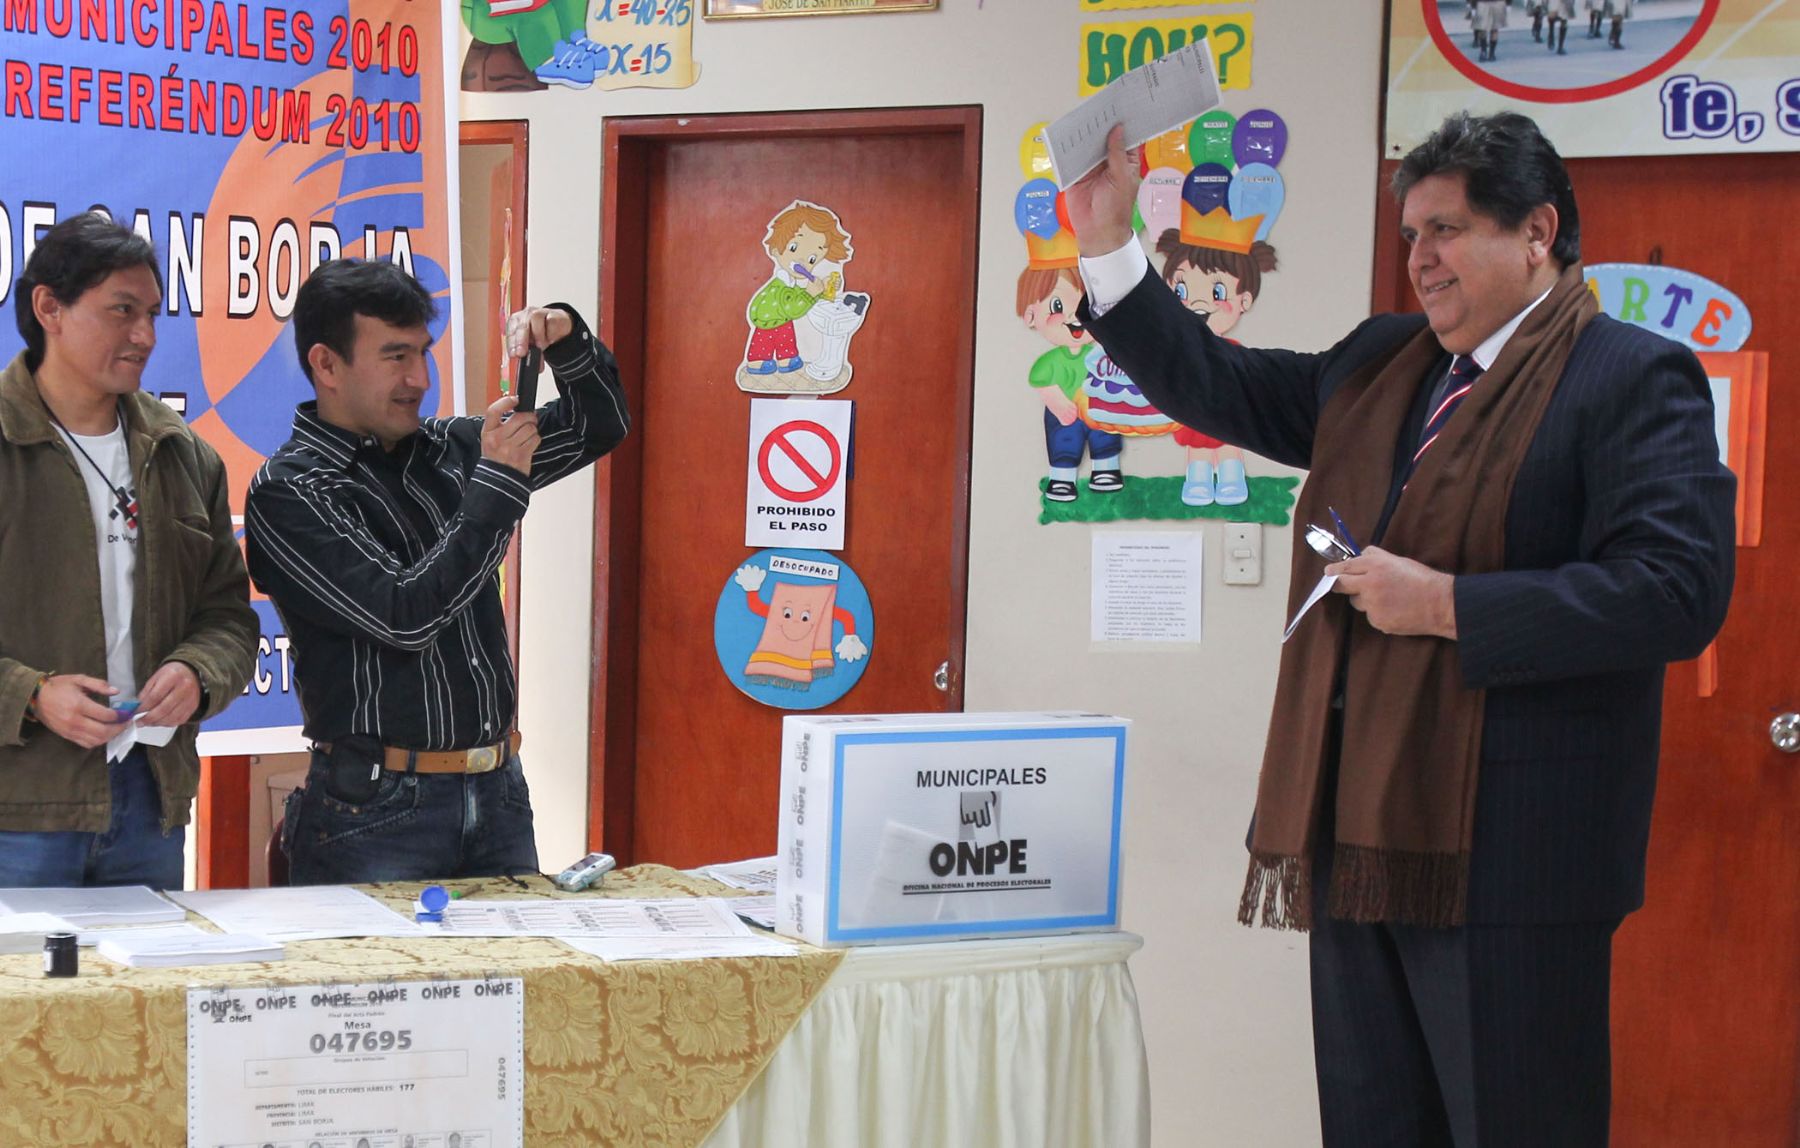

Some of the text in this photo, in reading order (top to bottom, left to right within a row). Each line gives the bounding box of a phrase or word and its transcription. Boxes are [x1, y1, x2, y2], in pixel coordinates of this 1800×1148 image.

[4, 0, 418, 78] MUNICIPALES 2010
[4, 59, 420, 153] REFERÉNDUM 2010
[1661, 75, 1764, 142] fe,
[757, 506, 836, 517] PROHIBIDO
[769, 521, 828, 532] EL PASO
[772, 559, 834, 576] DESOCUPADO
[242, 635, 291, 696] CT
[917, 767, 1047, 788] MUNICIPALES
[929, 839, 1027, 877] ONPE
[903, 883, 930, 891] OFICINA
[931, 882, 964, 890] NACIONAL
[1011, 879, 1051, 887] ELECTORALES
[200, 999, 241, 1013] ONPE
[256, 996, 296, 1010] ONPE
[311, 993, 351, 1007] ONPE
[367, 989, 408, 1004] ONPE
[421, 986, 460, 999] ONPE
[474, 983, 513, 997] ONPE
[344, 1021, 371, 1030] Mesa
[310, 1030, 412, 1054] 047695
[400, 1084, 415, 1092] 177
[498, 1057, 506, 1100] 047695
